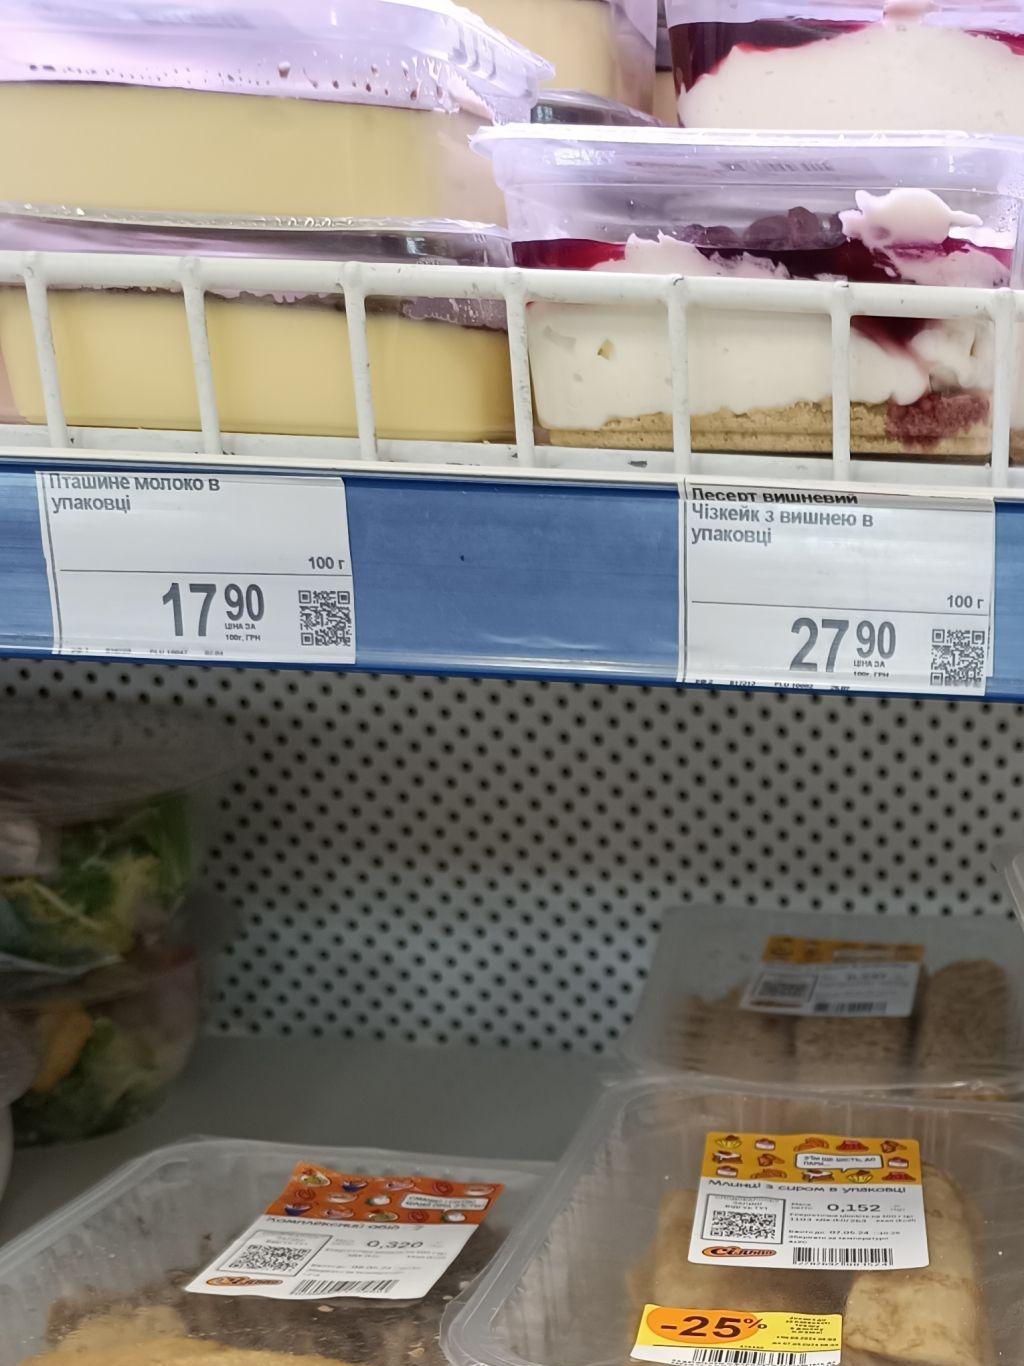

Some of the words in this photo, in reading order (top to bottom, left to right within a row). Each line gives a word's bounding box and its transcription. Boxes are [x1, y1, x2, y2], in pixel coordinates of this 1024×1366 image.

[49, 473, 131, 493] Пташине
[134, 476, 204, 493] молоко
[207, 479, 220, 492] в
[51, 494, 133, 513] упаковці
[692, 503, 760, 524] Чізкейк
[764, 509, 775, 524] з
[780, 510, 857, 528] вишнею
[862, 512, 874, 528] в
[692, 525, 773, 547] упаковці
[308, 556, 332, 570] 100
[336, 559, 345, 571] г
[162, 582, 217, 638] 17
[225, 583, 265, 622] 90
[946, 595, 973, 609] 100
[976, 598, 985, 609] г
[789, 616, 849, 674] 27
[856, 620, 897, 660] 90
[827, 1203, 881, 1212] 0,152
[660, 1315, 768, 1338] -25%
